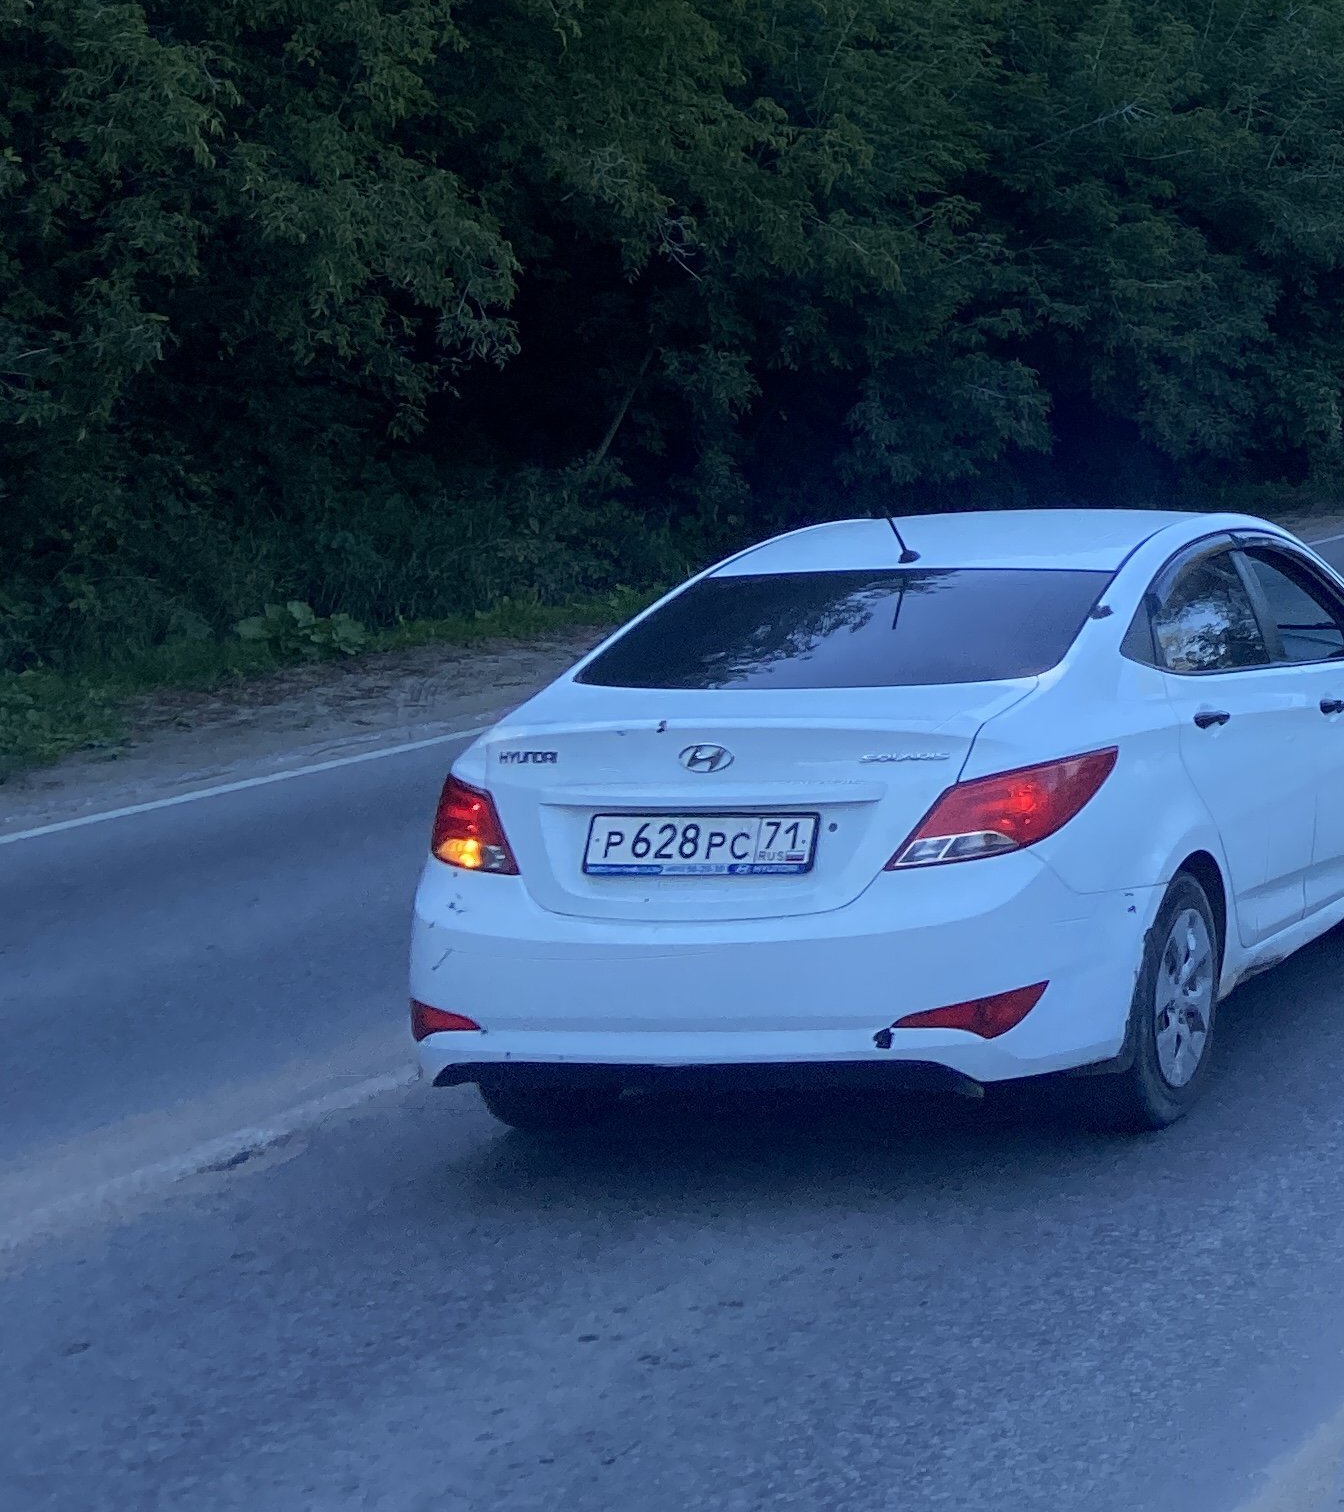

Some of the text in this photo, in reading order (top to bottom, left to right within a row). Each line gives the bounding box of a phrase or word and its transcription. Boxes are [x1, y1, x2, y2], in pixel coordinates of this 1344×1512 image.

[499, 751, 558, 764] HYUNDAI
[765, 821, 800, 849] 71
[758, 851, 785, 861] RUS
